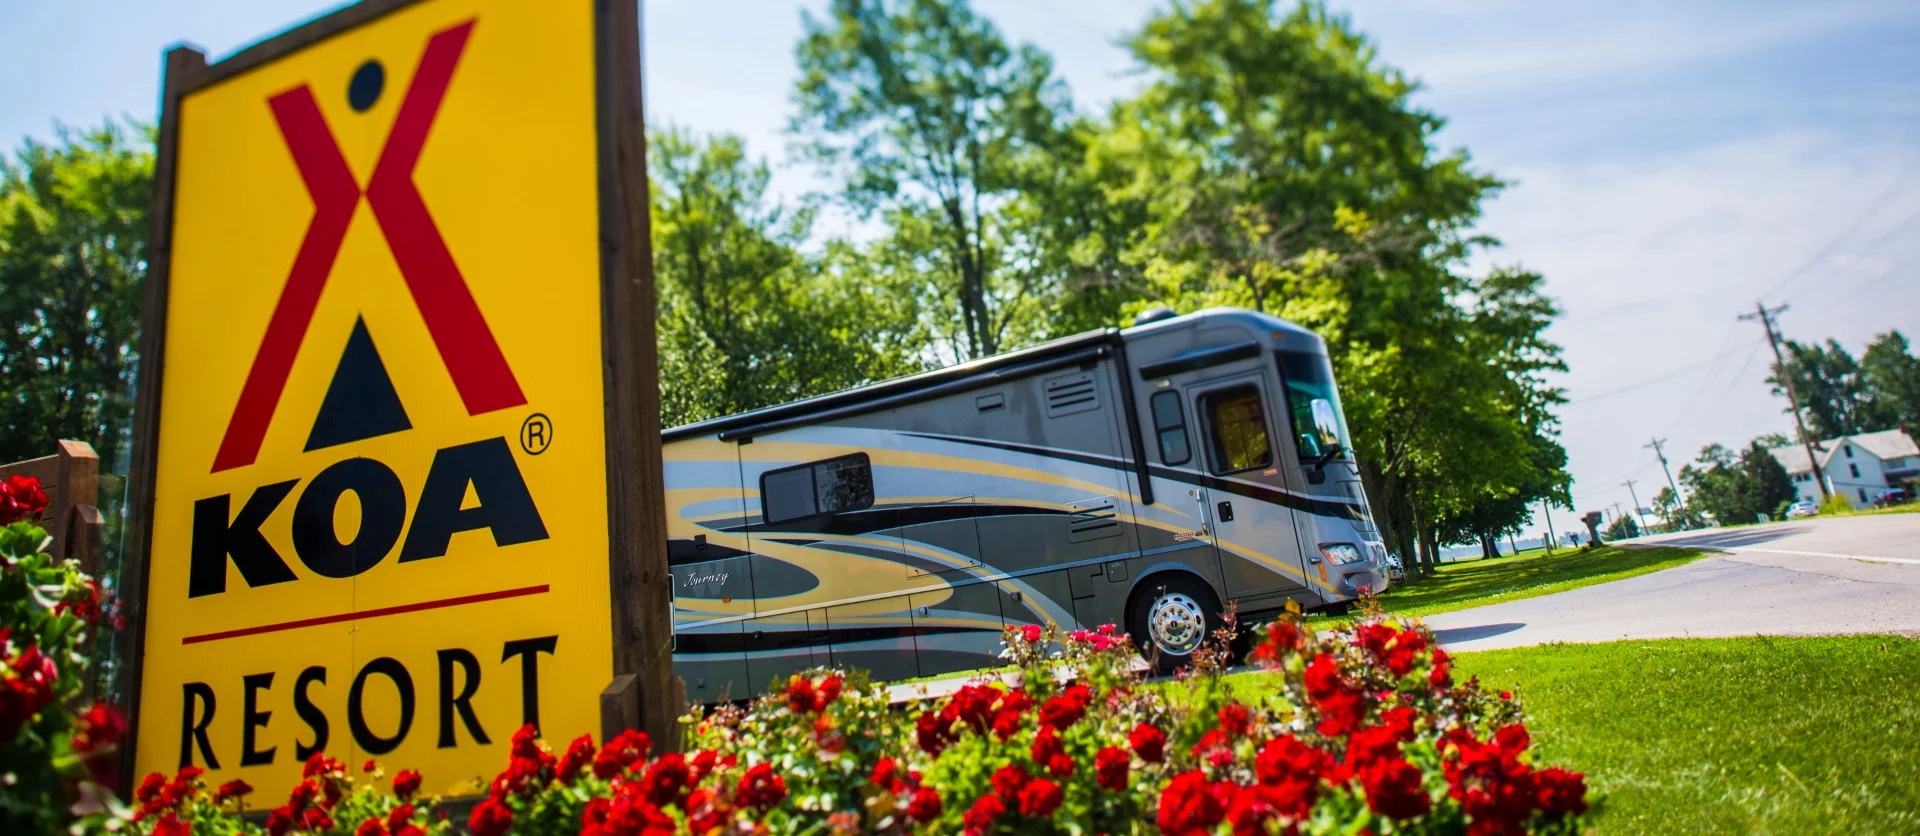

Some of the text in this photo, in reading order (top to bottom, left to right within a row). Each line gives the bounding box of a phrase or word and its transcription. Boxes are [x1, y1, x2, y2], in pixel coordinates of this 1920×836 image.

[188, 436, 550, 599] KOA
[683, 572, 730, 588] Journey
[179, 635, 558, 771] RESORT
